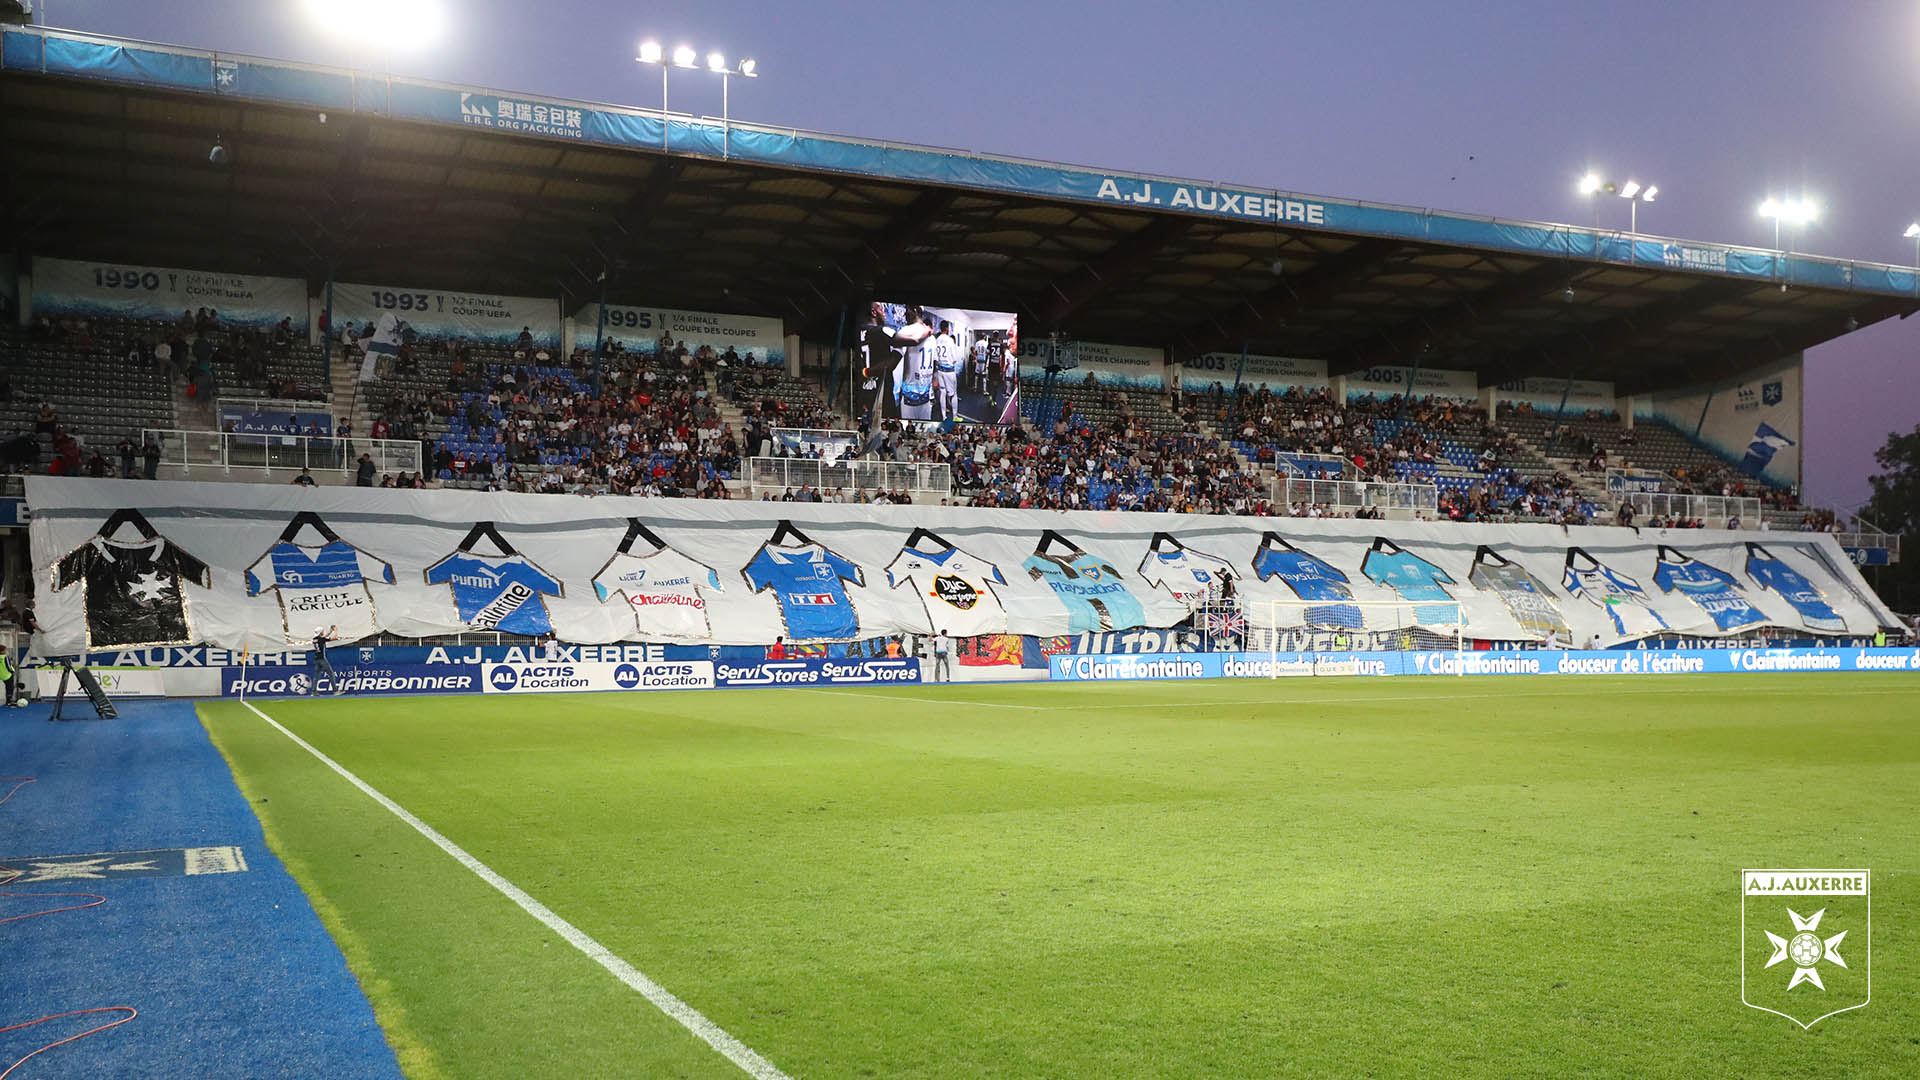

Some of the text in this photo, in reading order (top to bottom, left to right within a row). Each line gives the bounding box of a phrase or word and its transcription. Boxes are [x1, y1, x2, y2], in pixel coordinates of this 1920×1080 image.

[497, 119, 582, 138] ORG PACKAGING
[1097, 178, 1324, 224] A.J. AUXERRE
[93, 269, 159, 290] 1990
[225, 289, 254, 299] UEFA
[371, 291, 429, 311] 1993
[469, 298, 504, 308] FINALE
[452, 307, 512, 318] COUPE UEFA
[602, 309, 652, 329] 1995
[672, 314, 718, 325] 1/4 FINALE
[673, 324, 757, 337] COUPE DES COUPES
[919, 347, 933, 369] 11
[936, 345, 947, 358] 22
[991, 347, 1001, 357] 24
[1109, 357, 1151, 366] CHAMPIONS
[1183, 355, 1225, 371] 2003
[1363, 368, 1402, 383] 2005
[653, 577, 690, 586] AUXERRE
[108, 647, 307, 667] AUXERRE
[425, 645, 664, 664] A.J. AUXERRE
[1558, 651, 1619, 673] douceur
[1621, 651, 1639, 672] de
[1643, 651, 1704, 672] l'écriture
[1742, 650, 1920, 670] Clairefontaine douceur d
[492, 666, 575, 684] AL ACTIS
[615, 665, 695, 682] AL ACTIS
[1075, 657, 1203, 680] Clairefontaine
[230, 680, 287, 694] PICQ
[316, 676, 472, 692] CHARBONNIER
[521, 675, 589, 688] Location
[643, 674, 707, 687] Location
